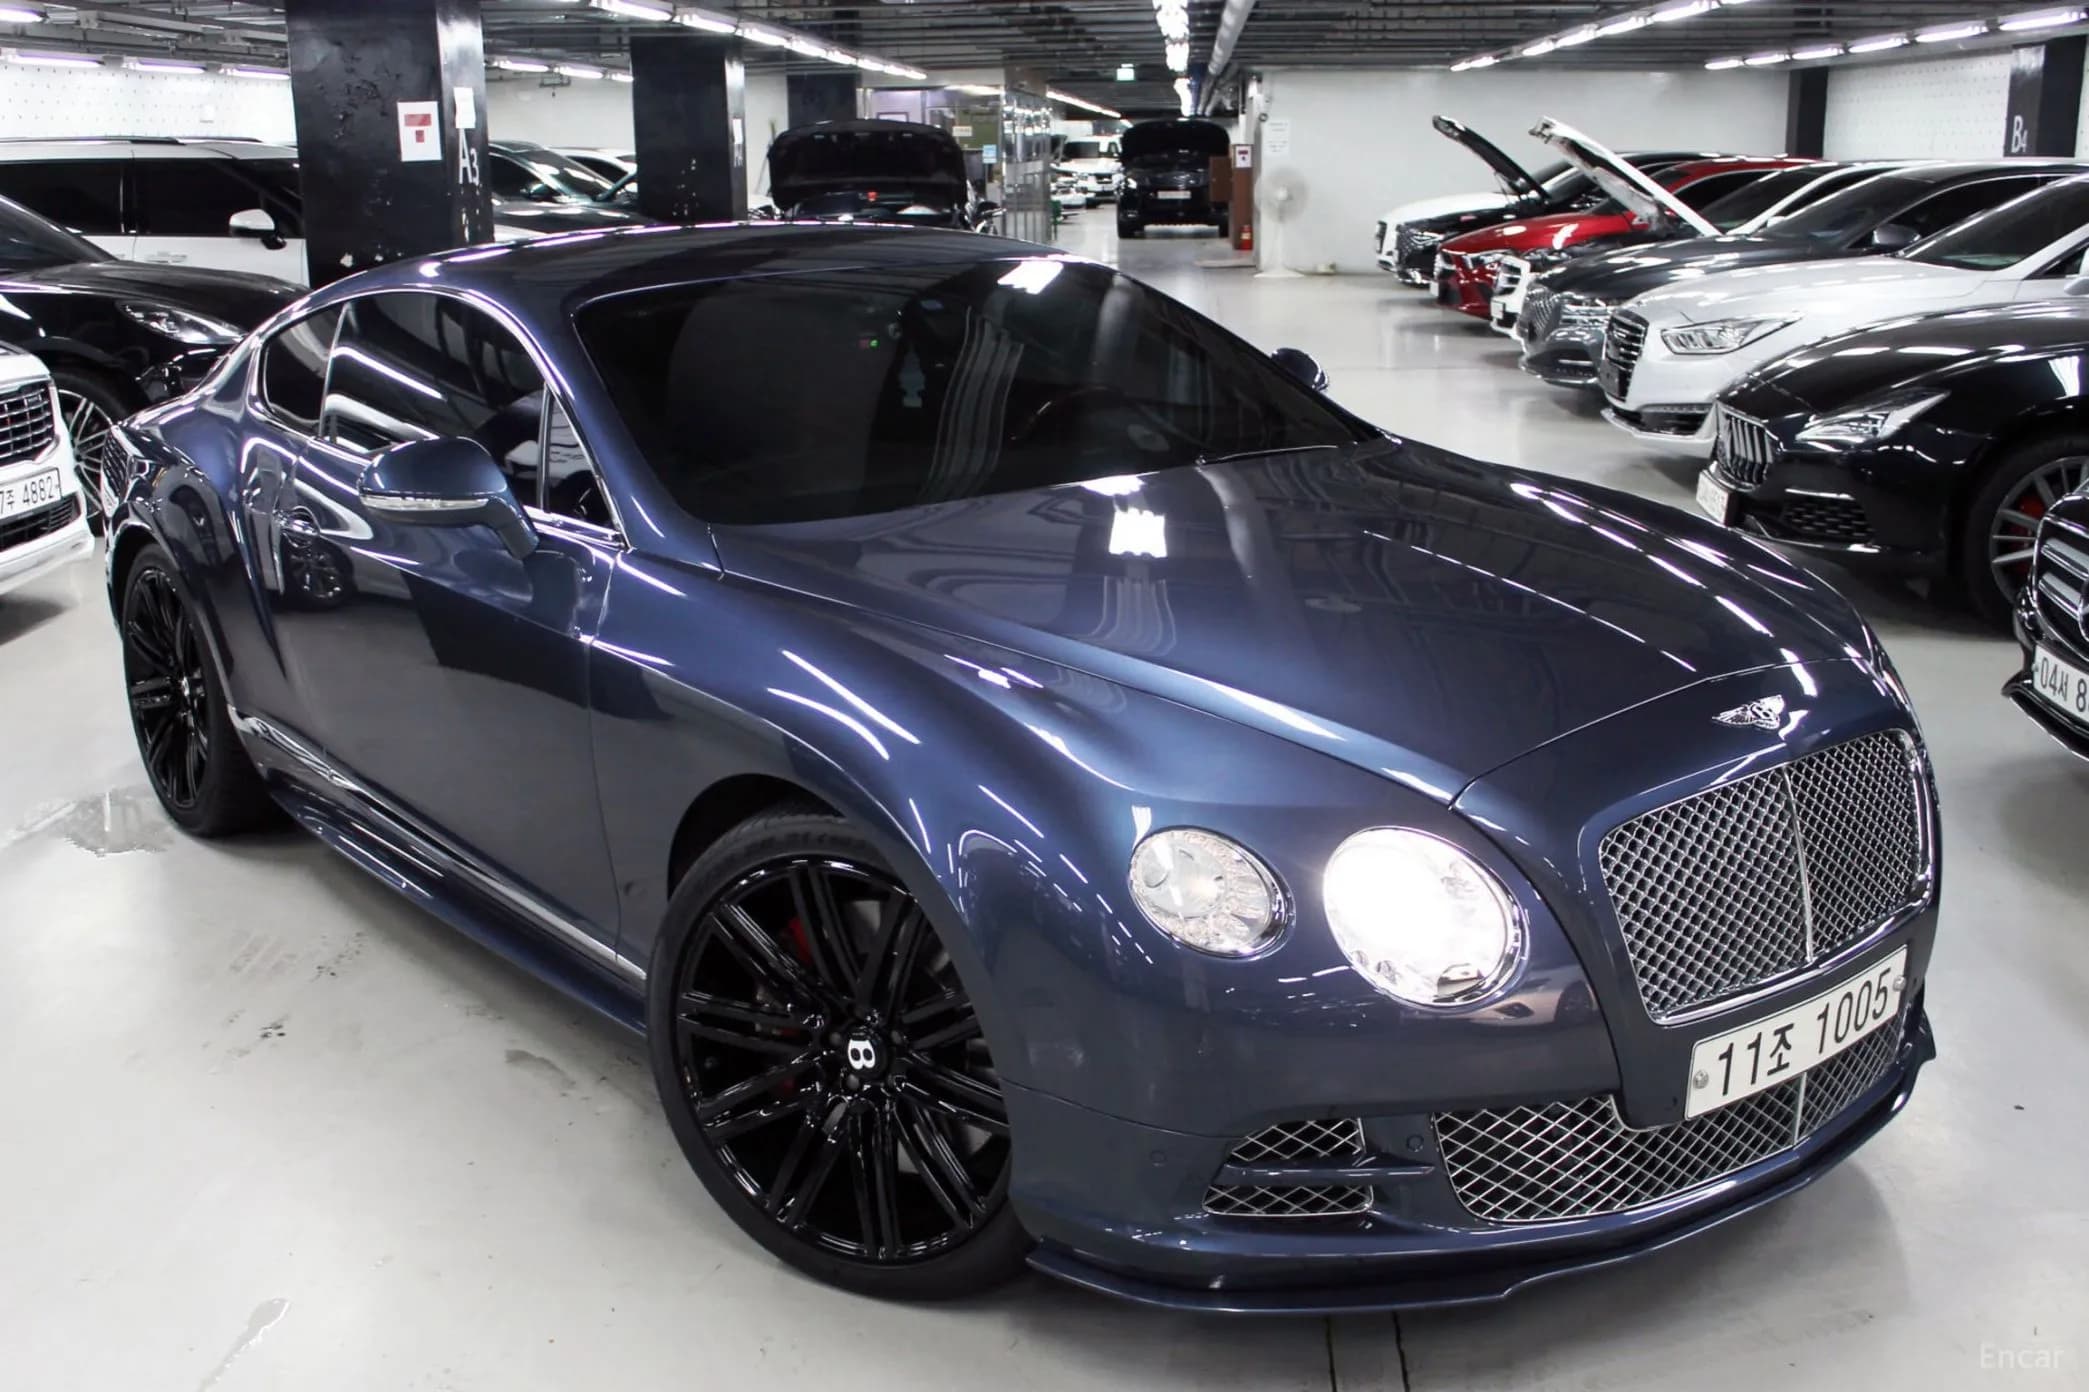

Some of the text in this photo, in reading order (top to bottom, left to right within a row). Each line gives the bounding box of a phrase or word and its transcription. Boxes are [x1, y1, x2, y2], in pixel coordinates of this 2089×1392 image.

[2011, 115, 2028, 153] B4
[459, 128, 480, 186] A3
[23, 476, 54, 506] 4882
[2076, 678, 2089, 713] 8
[1718, 967, 1891, 1097] 11조 1005
